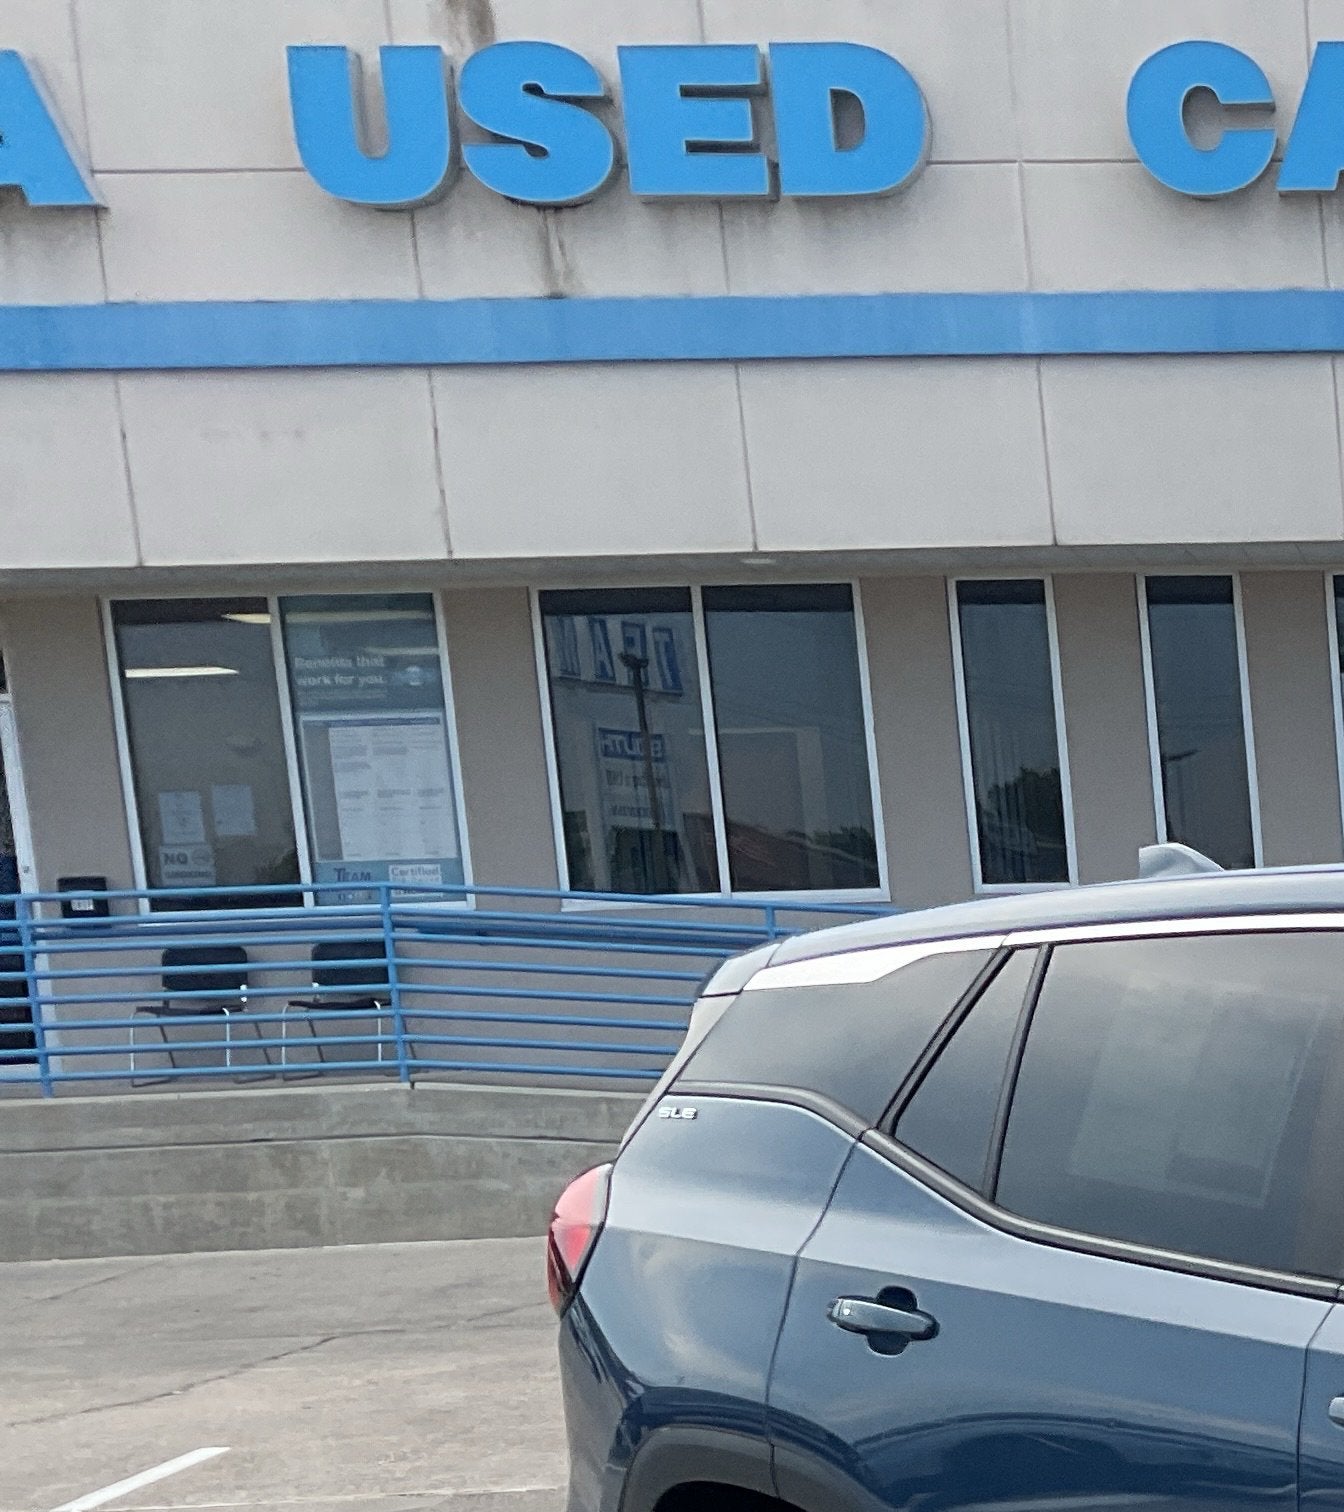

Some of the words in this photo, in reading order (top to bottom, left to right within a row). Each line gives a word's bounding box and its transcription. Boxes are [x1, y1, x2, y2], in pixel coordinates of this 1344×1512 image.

[286, 41, 931, 207] USED
[333, 867, 371, 882] TEAM
[659, 1106, 697, 1119] SLE
